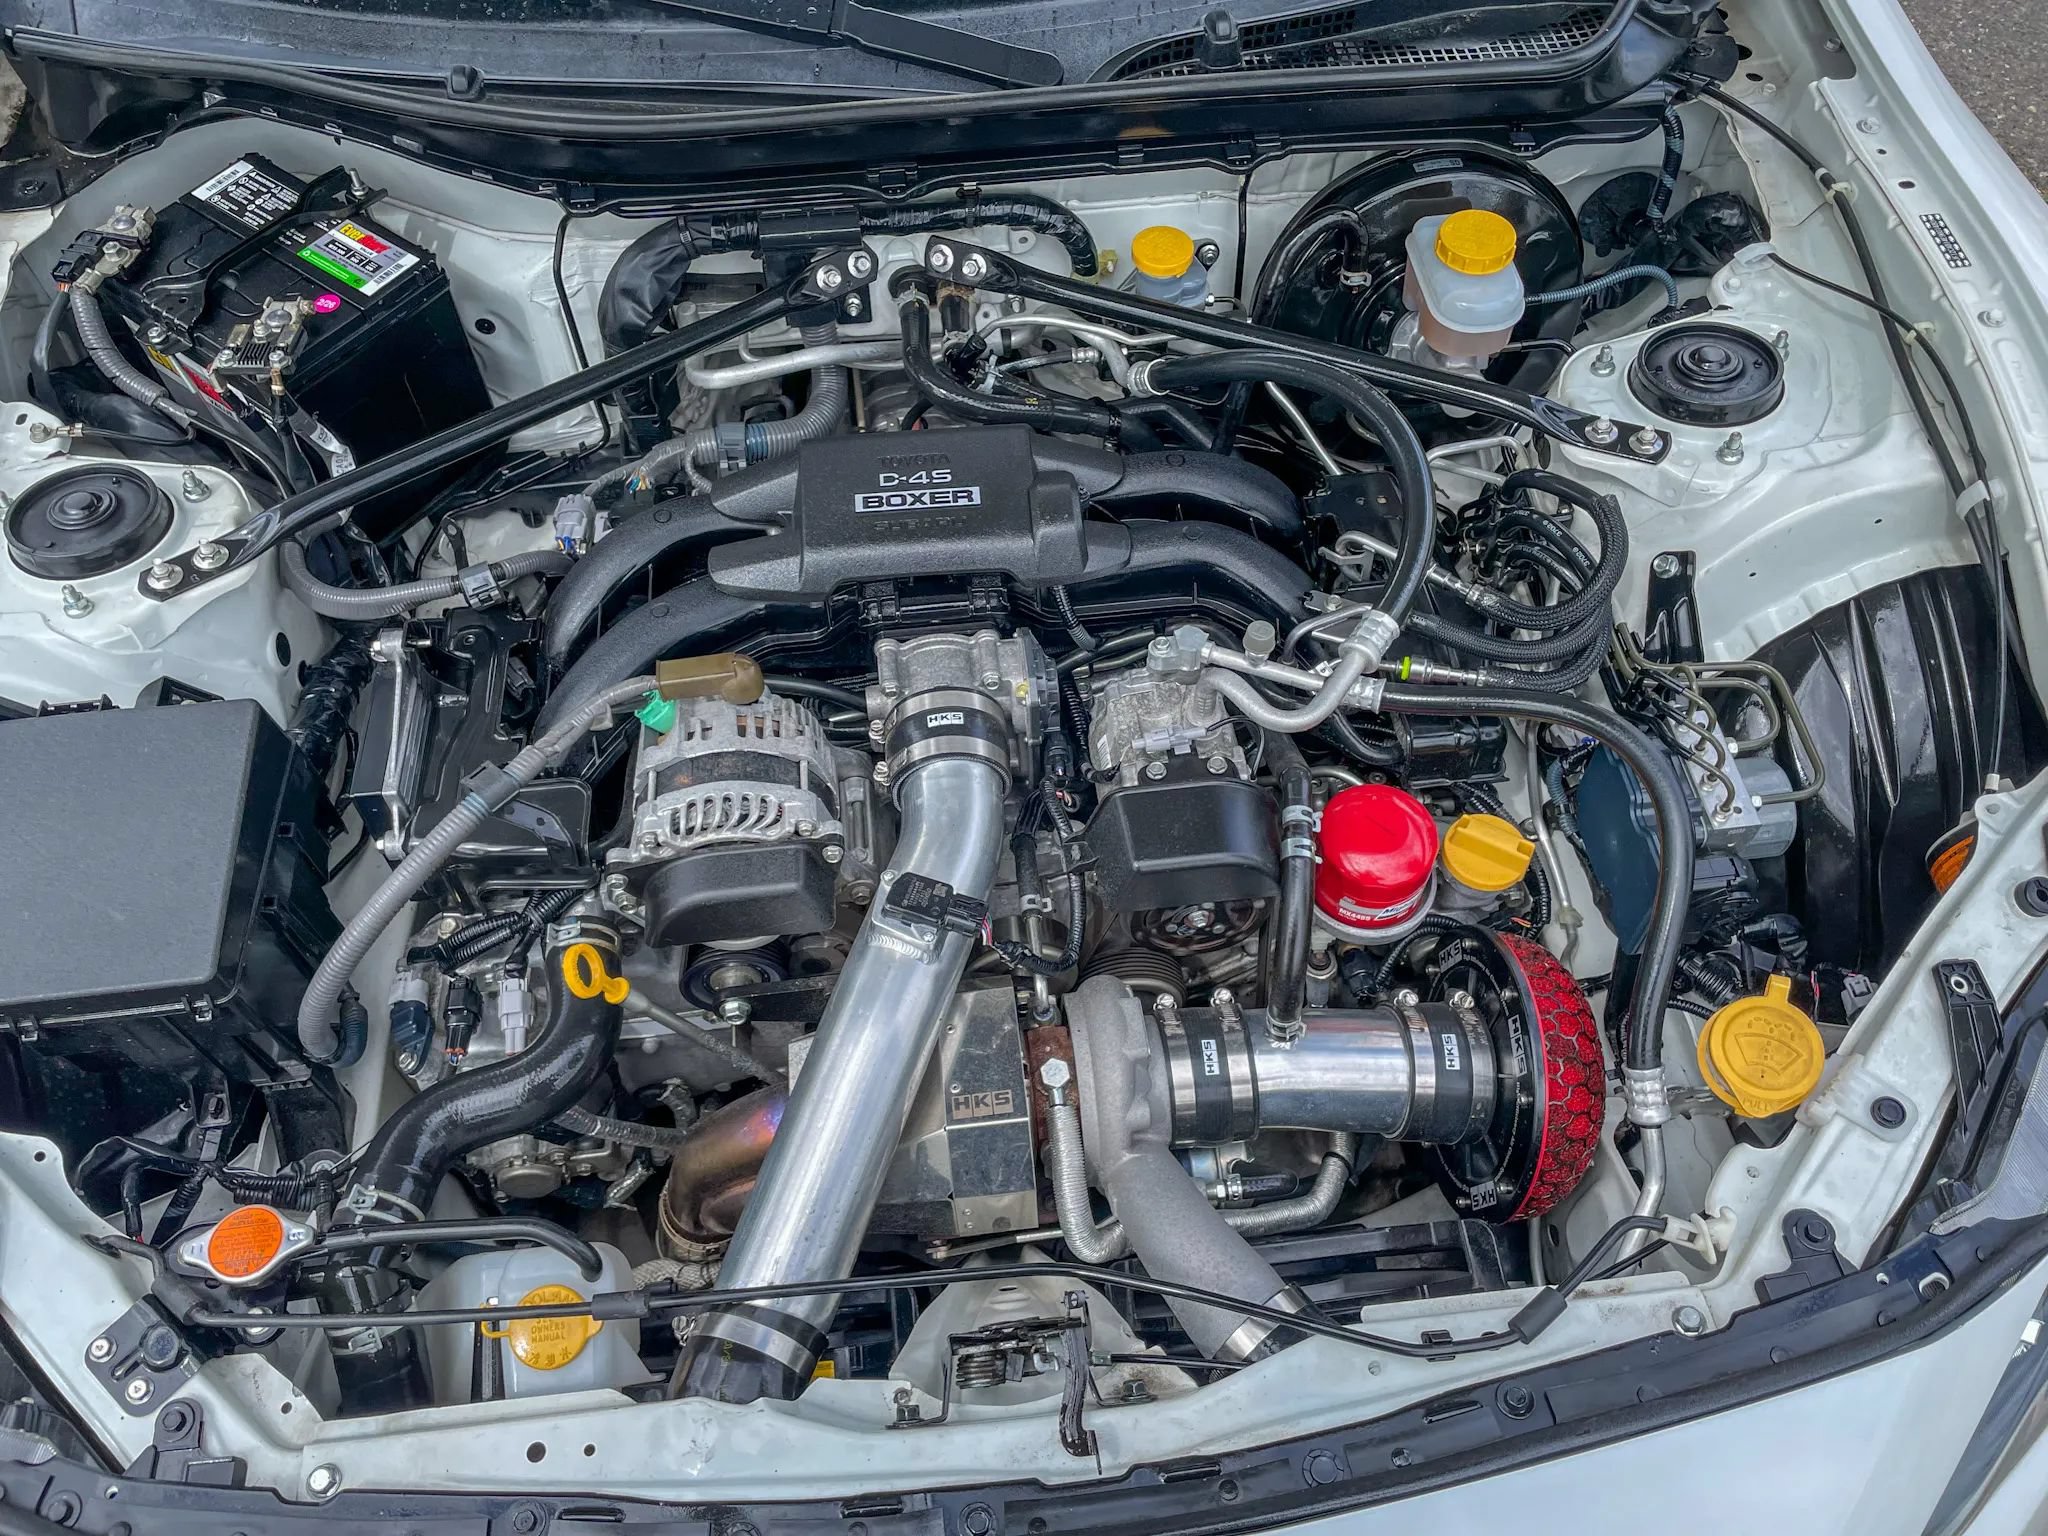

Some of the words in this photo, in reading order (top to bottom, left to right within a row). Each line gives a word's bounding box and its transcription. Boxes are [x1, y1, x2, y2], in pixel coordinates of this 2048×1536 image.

[878, 453, 950, 468] TOYOTA
[879, 469, 952, 487] D-4S
[862, 489, 975, 510] BOXER
[928, 713, 962, 723] HKS
[1440, 941, 1460, 966] HKS
[1444, 1035, 1456, 1068] HKS
[1510, 1016, 1526, 1073] HKS
[1203, 1041, 1215, 1074] HKS
[952, 1091, 1010, 1111] HKS
[1472, 1188, 1496, 1209] HKS
